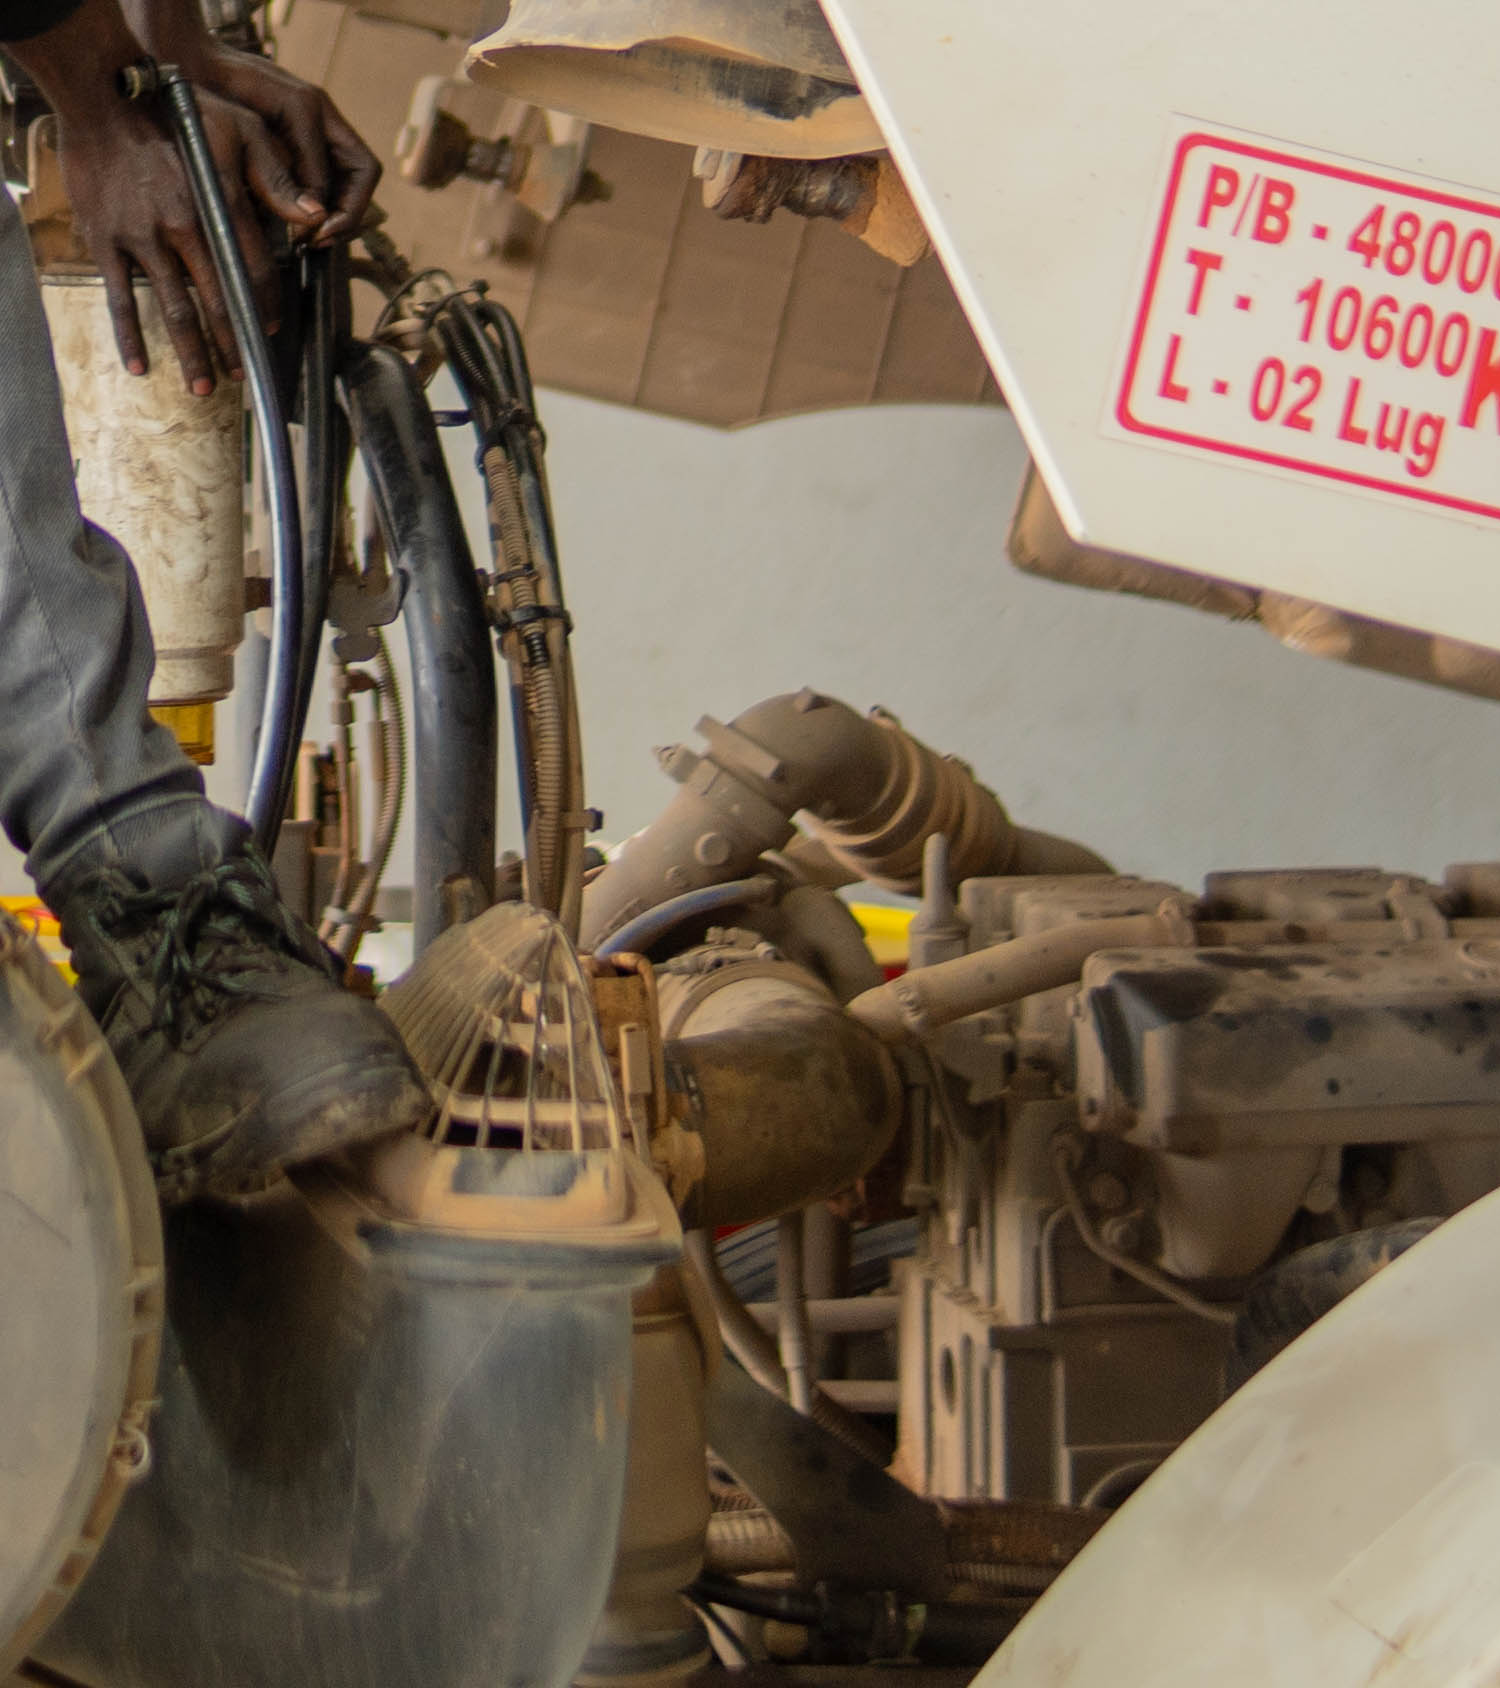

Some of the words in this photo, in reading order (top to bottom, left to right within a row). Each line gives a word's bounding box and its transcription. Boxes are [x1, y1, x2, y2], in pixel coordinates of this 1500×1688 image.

[1196, 163, 1296, 245] P/B
[1185, 248, 1224, 316] T
[1295, 277, 1470, 378] 10600
[1157, 333, 1190, 404] L
[1249, 356, 1324, 432] 02
[1336, 376, 1447, 479] Lug
